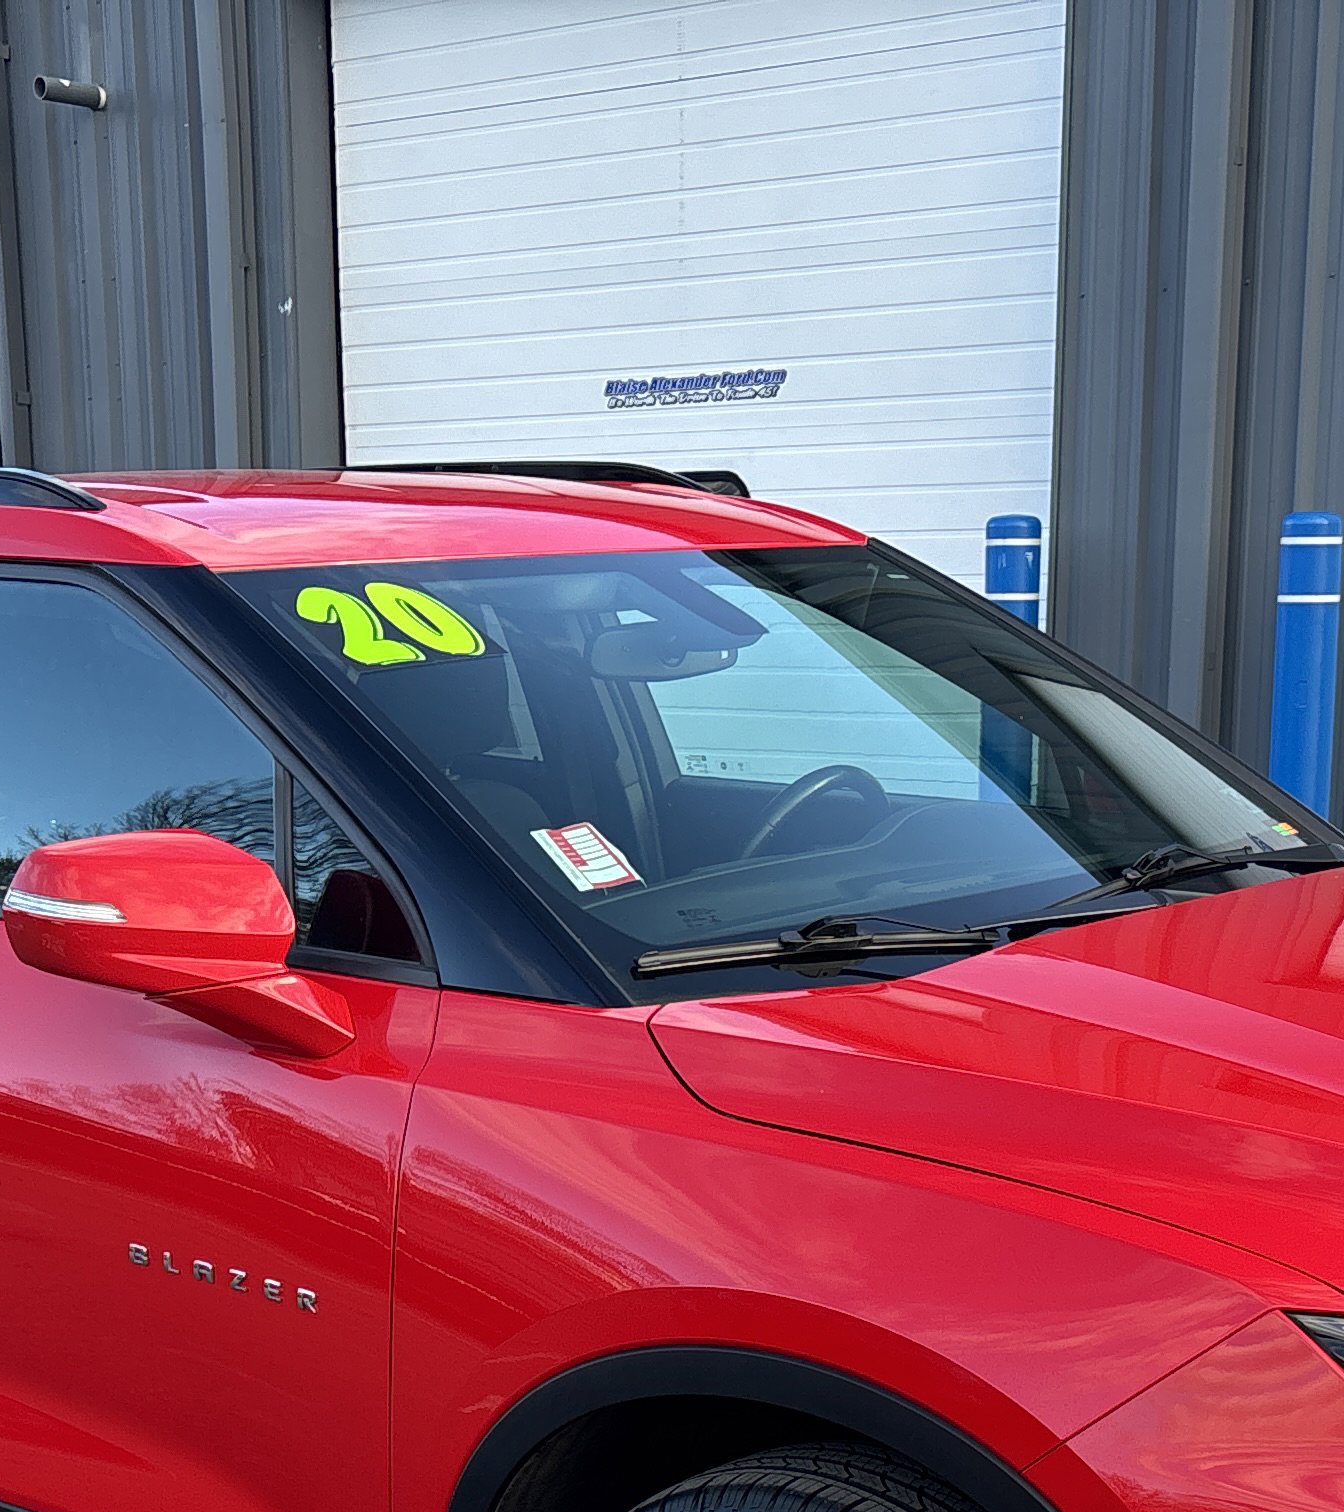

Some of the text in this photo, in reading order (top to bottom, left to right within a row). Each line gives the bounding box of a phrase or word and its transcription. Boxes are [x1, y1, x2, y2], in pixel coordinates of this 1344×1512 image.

[605, 379, 648, 396] Blaise
[649, 372, 721, 393] Alexander
[296, 582, 486, 666] 20
[128, 1243, 318, 1315] BLAZER
